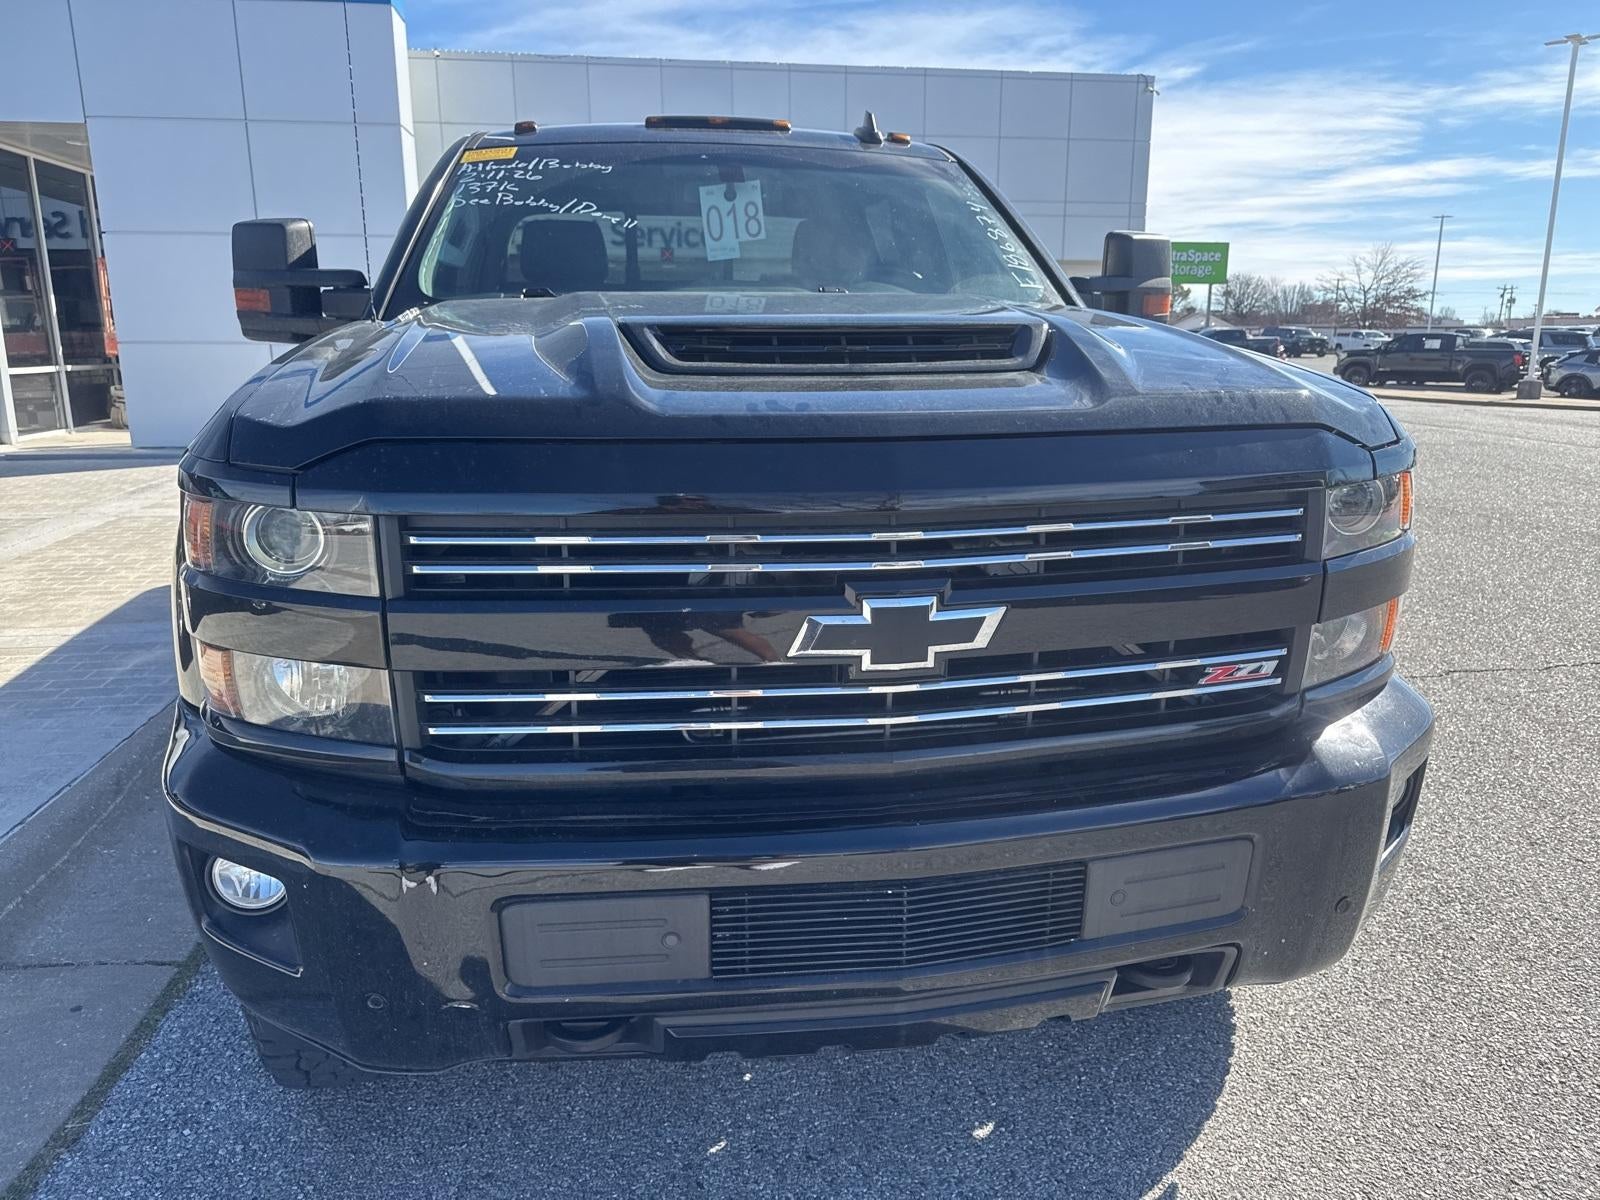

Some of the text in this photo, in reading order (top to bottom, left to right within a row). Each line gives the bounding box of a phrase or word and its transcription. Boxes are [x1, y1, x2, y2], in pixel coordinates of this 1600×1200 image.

[611, 221, 706, 249] Servic
[706, 200, 762, 243] 018
[1172, 249, 1222, 264] traSpace
[1198, 659, 1279, 685] Z71
